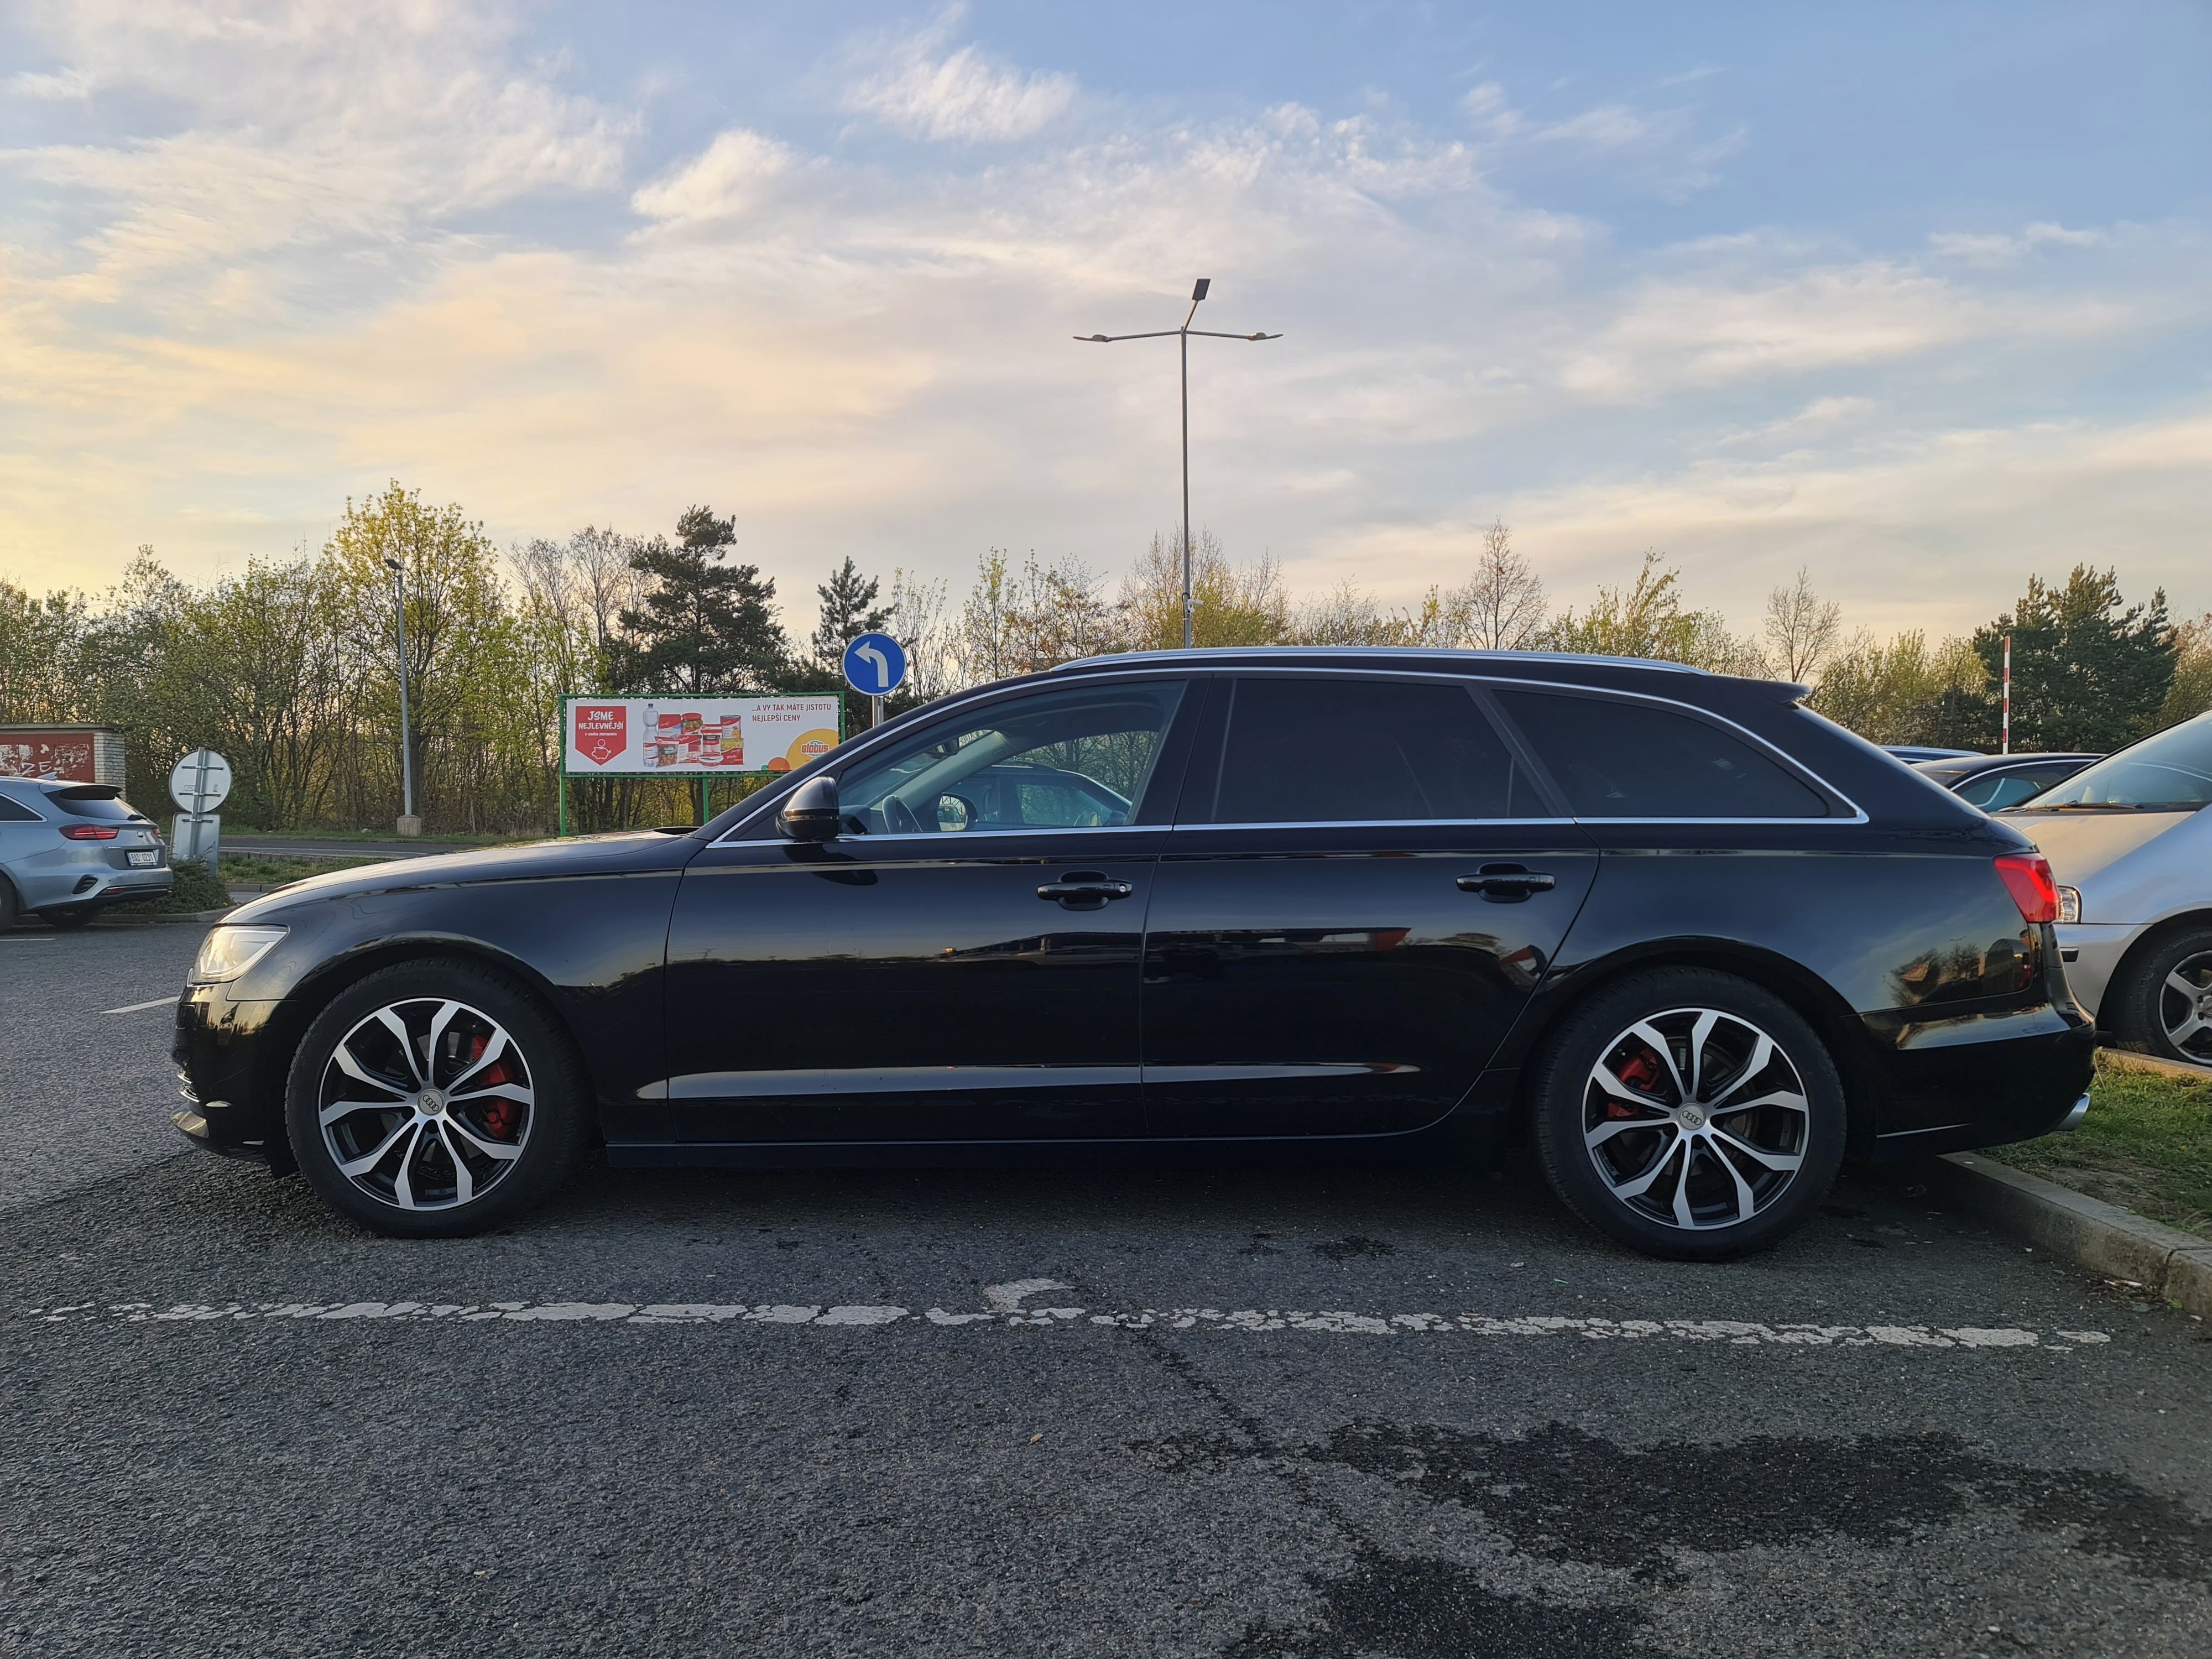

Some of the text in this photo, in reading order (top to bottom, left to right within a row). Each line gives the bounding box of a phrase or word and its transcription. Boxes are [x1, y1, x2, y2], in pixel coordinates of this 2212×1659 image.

[786, 702, 804, 711] MÁTE
[587, 711, 614, 721] JSME
[752, 713, 781, 722] NEJLEPŠÍ
[578, 721, 624, 729] NEJLEVNĚJŠÍ
